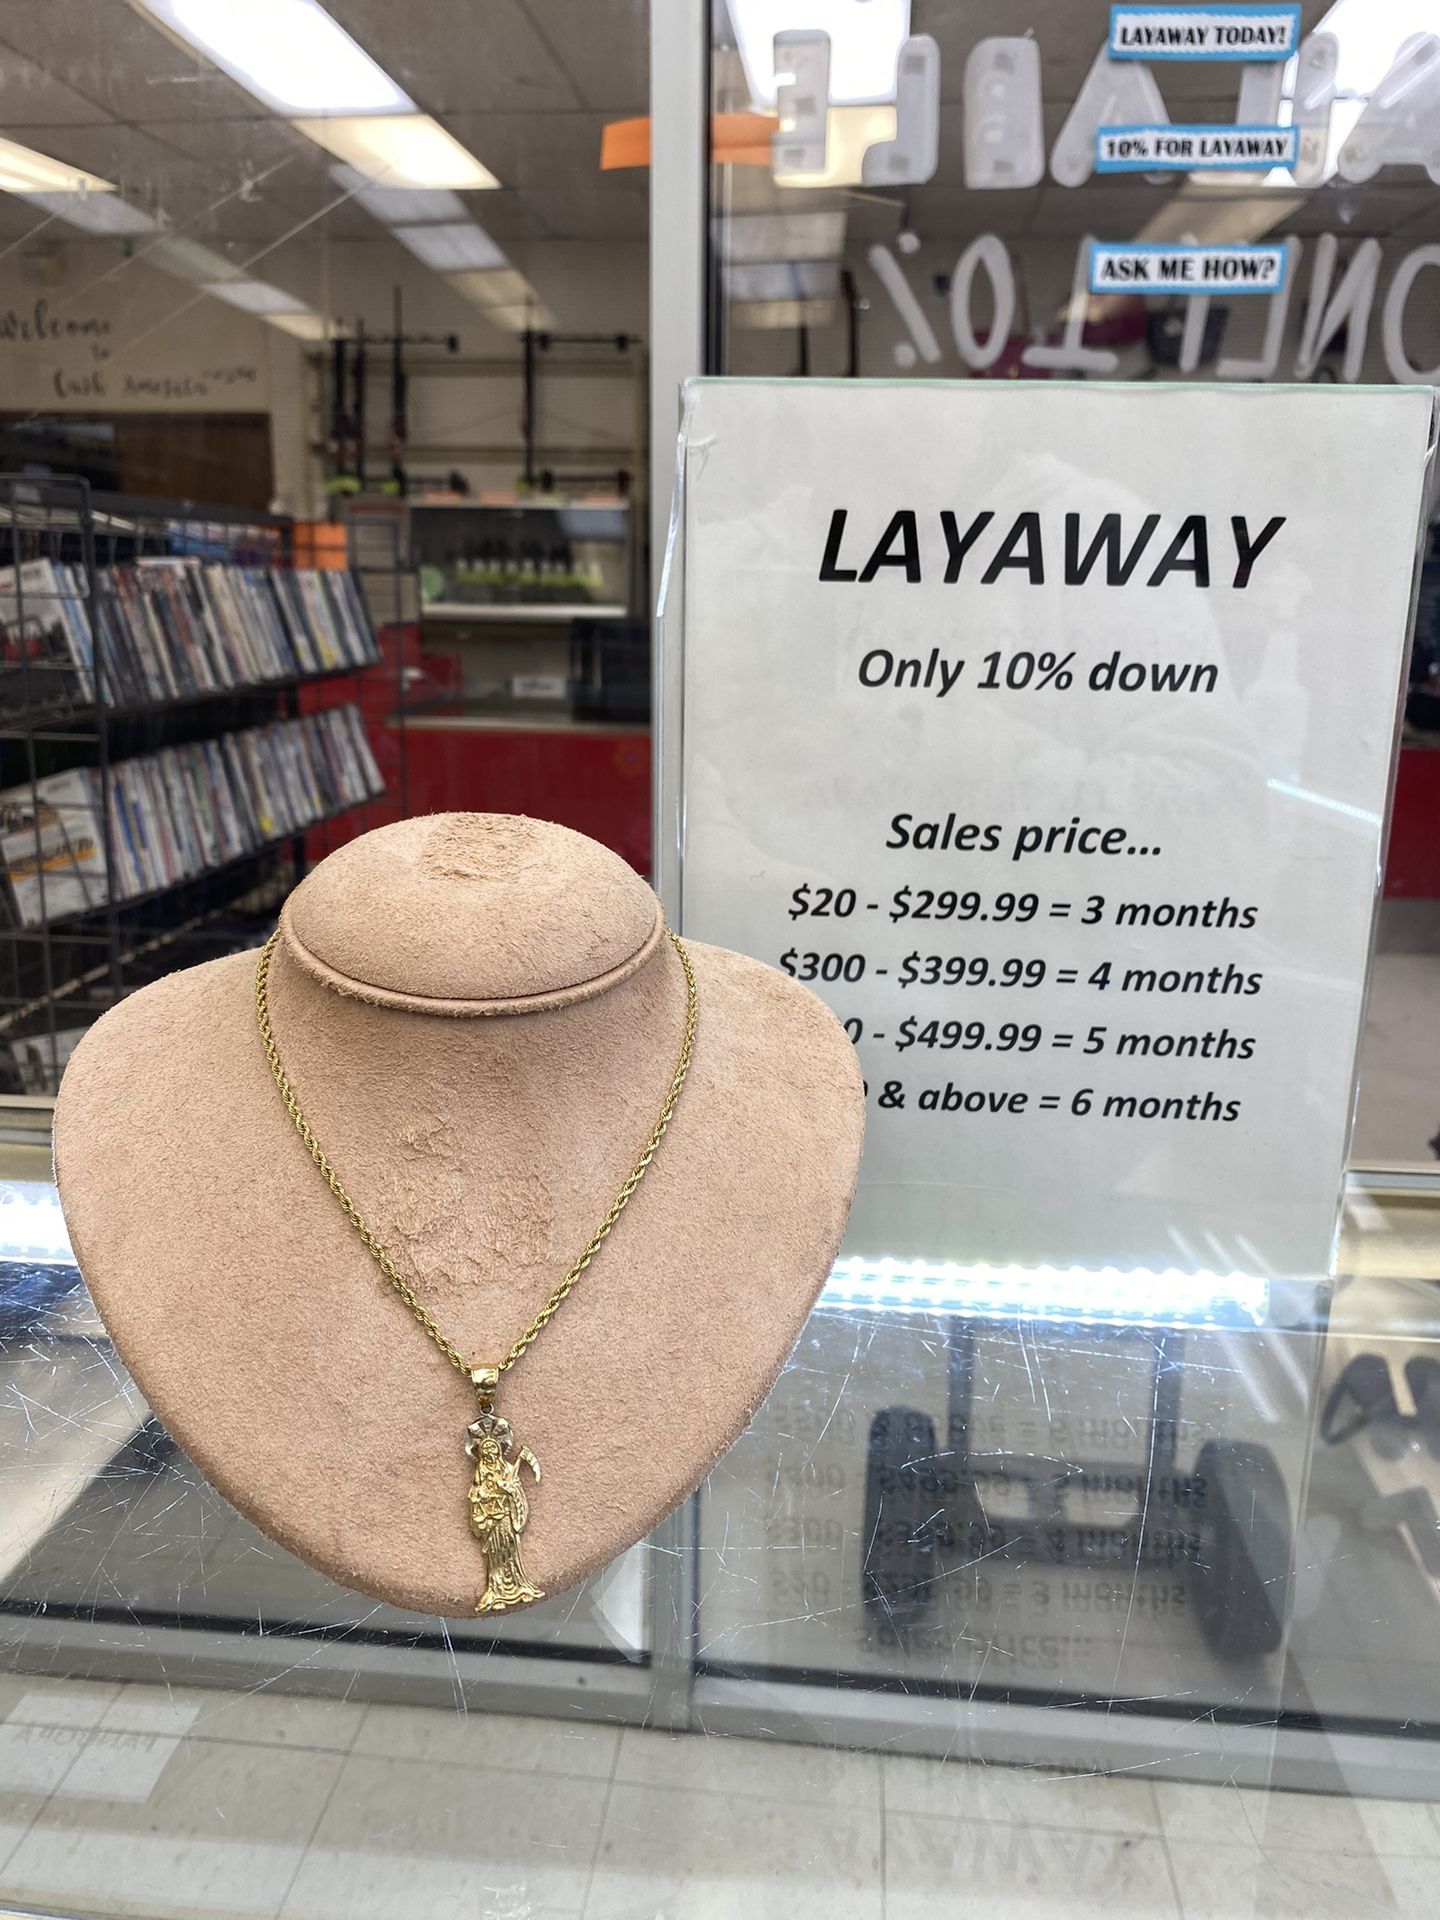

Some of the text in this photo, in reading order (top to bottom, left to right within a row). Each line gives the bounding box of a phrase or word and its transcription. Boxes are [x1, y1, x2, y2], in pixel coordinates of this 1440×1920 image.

[1121, 25, 1287, 46] LAYAWAY TODAY!
[1106, 138, 1287, 158] 10% FOR LAYAWAY
[1102, 256, 1277, 281] ASK ME HOW?
[818, 508, 1287, 589] LAYAWAY
[858, 647, 1218, 698] Only 10% down
[885, 812, 1161, 862] Sales price...
[788, 883, 857, 921] $20
[888, 885, 1039, 924] $299.99
[1048, 903, 1072, 918] =
[1080, 895, 1105, 925] 3
[1115, 896, 1259, 929] months
[779, 948, 866, 983] $300
[897, 950, 1047, 989] $399.99
[1056, 969, 1079, 984] =
[1087, 961, 1112, 991] 4
[1121, 963, 1263, 995] months
[894, 1015, 1042, 1053] $499.99
[1051, 1034, 1074, 1048] =
[1082, 1026, 1107, 1055] 5
[1116, 1028, 1256, 1060] months
[877, 1080, 906, 1110] &
[918, 1081, 1029, 1114] above
[1038, 1095, 1061, 1109] =
[1071, 1088, 1094, 1116] 6
[1102, 1091, 1241, 1122] months
